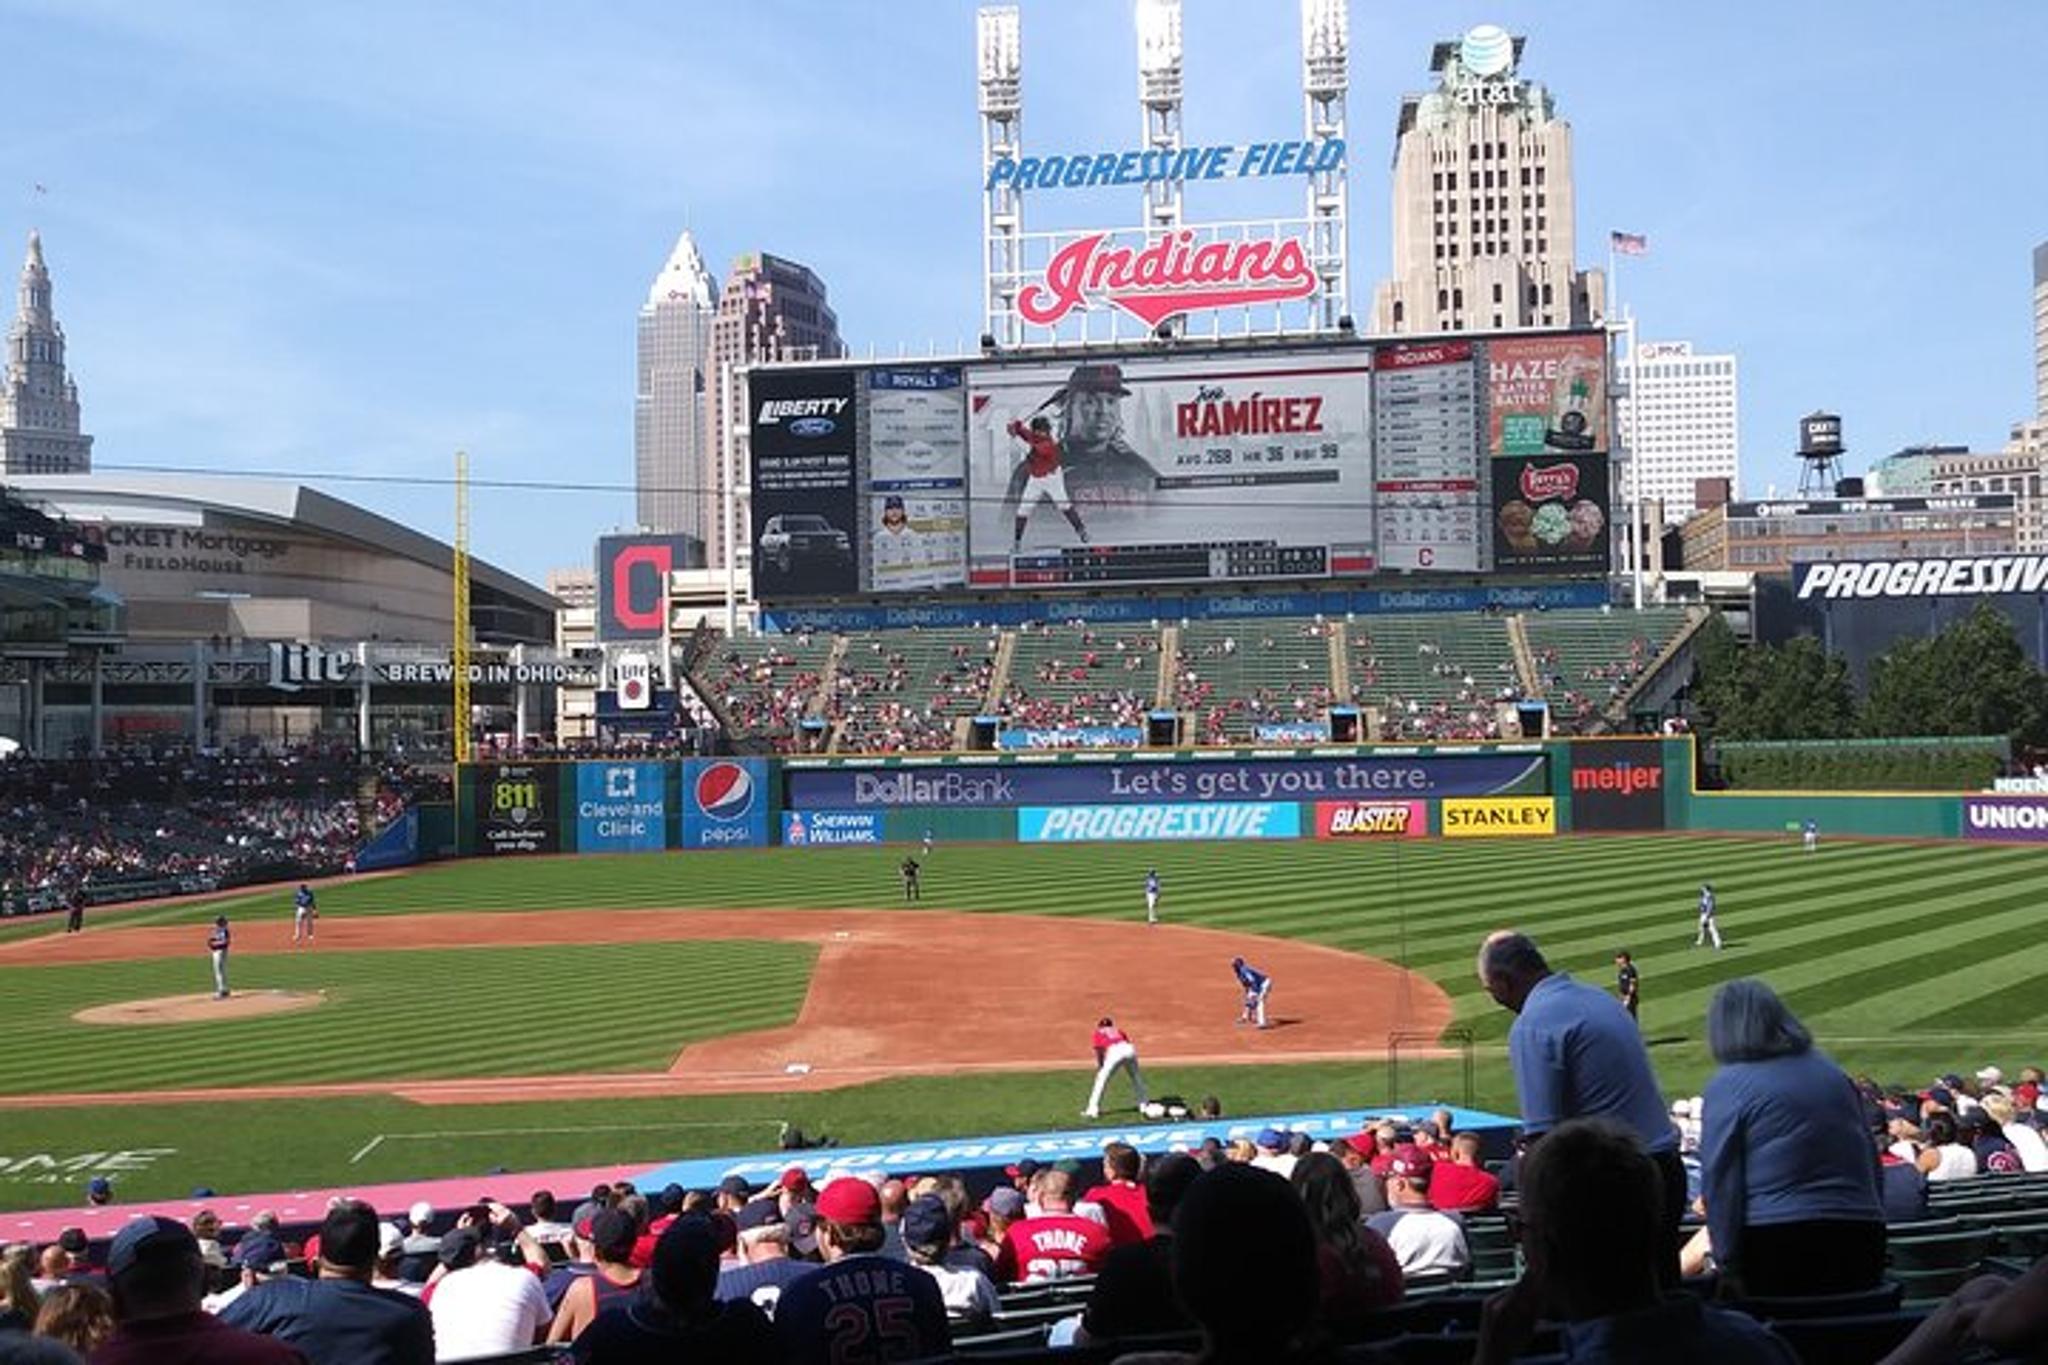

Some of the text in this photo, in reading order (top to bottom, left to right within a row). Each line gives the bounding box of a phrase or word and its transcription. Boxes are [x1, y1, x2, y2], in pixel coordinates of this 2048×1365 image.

[1456, 78, 1520, 106] at&t
[985, 138, 1346, 191] PROGRESSIVE FIELD
[1017, 230, 1318, 327] Indians
[758, 397, 849, 424] LIBERTY
[1177, 391, 1324, 438] RAMÍREZ
[1206, 449, 1232, 464] .268
[1419, 548, 1435, 567] C
[613, 546, 671, 630] C
[268, 642, 352, 692] Lite
[488, 664, 510, 682] IN
[516, 664, 566, 681] OHIO
[1111, 758, 1435, 799] Let's get you there.
[1572, 762, 1661, 795] meijer
[497, 784, 534, 808] 811
[580, 801, 663, 819] Cleveland
[811, 812, 873, 828] SHERWIN
[1040, 804, 1270, 840] PROGRESSIVE
[1447, 807, 1550, 826] STANLEY
[1970, 804, 2048, 829] UNION
[598, 821, 645, 837] Clinic
[701, 827, 750, 843] pepsi
[818, 1270, 906, 1301] THOME
